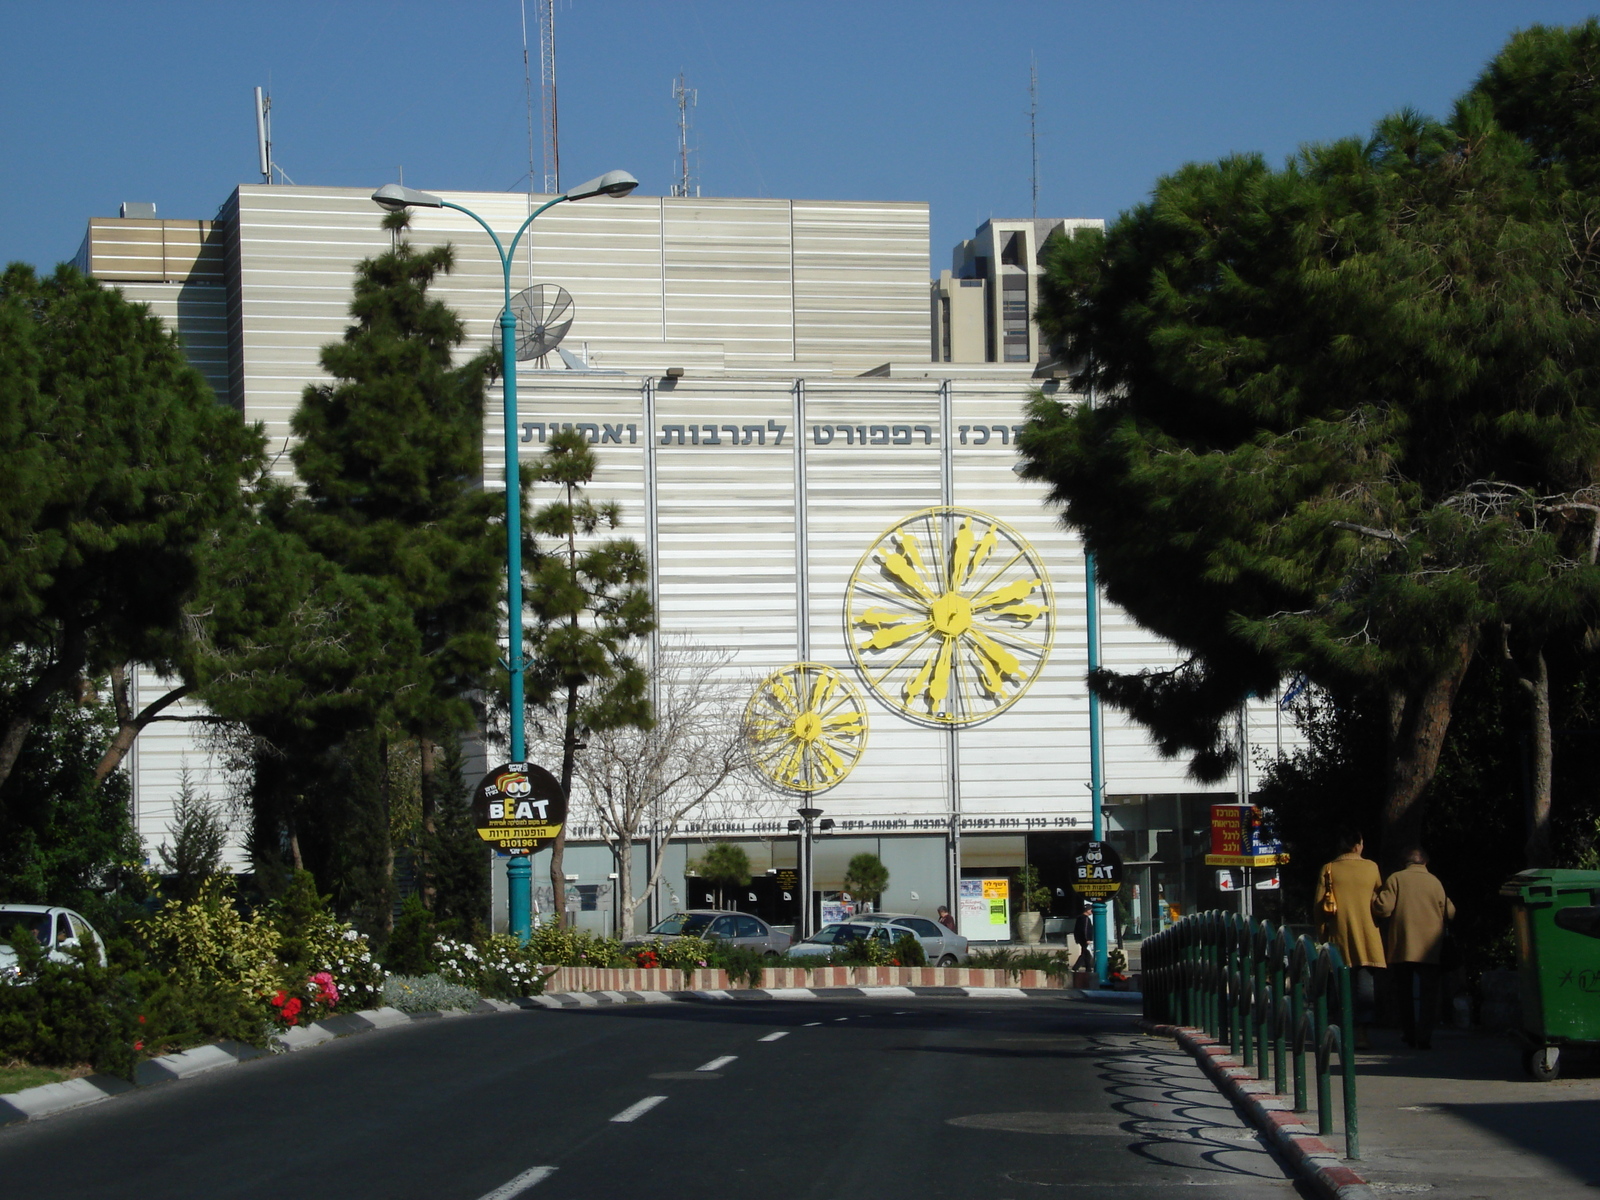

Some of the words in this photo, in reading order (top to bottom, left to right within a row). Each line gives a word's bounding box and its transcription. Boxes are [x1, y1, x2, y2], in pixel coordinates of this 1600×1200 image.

[660, 419, 788, 446] לתרבות
[813, 424, 932, 446] רפפורט
[489, 798, 549, 820] BEAT
[1216, 809, 1240, 818] המרכז
[842, 819, 864, 830] חיפה
[913, 817, 946, 830] לתרבות
[961, 818, 995, 829] רפפורט
[999, 818, 1019, 829] ורות
[1025, 817, 1047, 830] ברוך
[1054, 816, 1077, 828] מרכז
[1211, 819, 1240, 828] הבריאותי
[489, 830, 510, 838] חיות
[513, 829, 547, 837] הופעות
[1222, 830, 1240, 840] לרגל
[499, 839, 538, 848] 8101961
[1223, 842, 1240, 852] ולגב
[1078, 864, 1114, 879] BEAT
